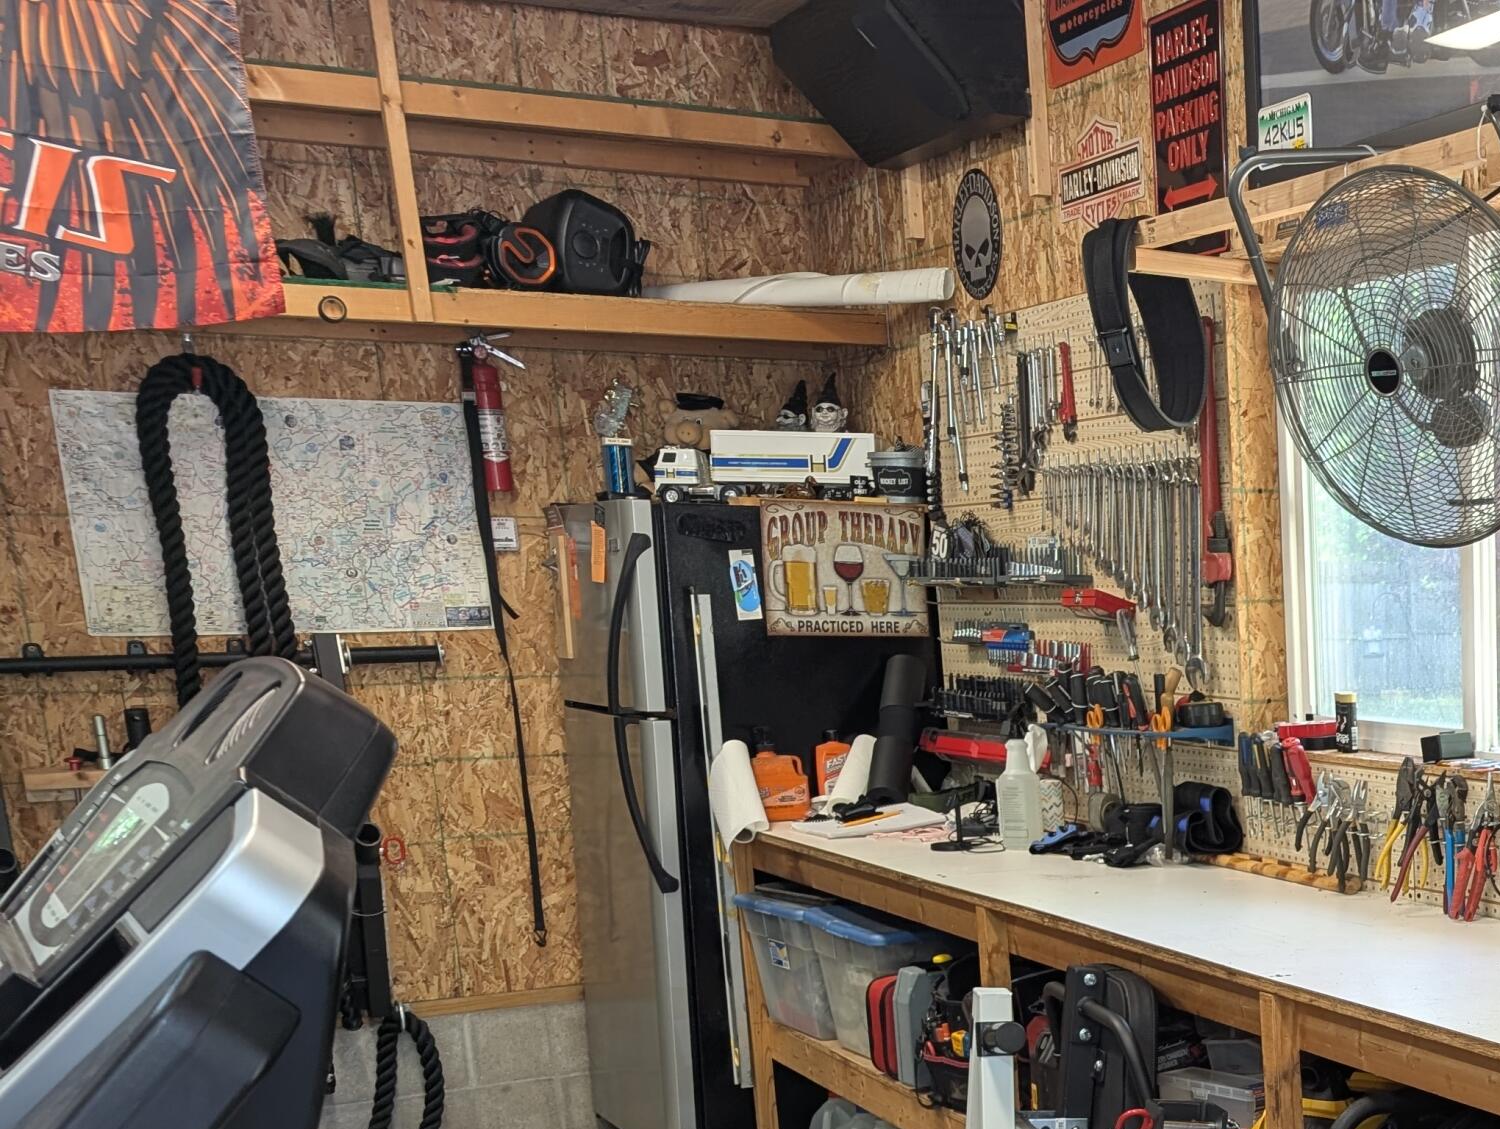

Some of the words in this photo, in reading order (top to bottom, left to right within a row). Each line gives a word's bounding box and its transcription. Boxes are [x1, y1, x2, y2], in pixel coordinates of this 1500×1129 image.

[1059, 0, 1123, 33] motorcycles
[1155, 14, 1213, 65] HARLEY-
[1154, 51, 1217, 104] DAVIDSON
[1156, 91, 1219, 141] PARKING
[1268, 103, 1300, 121] MICHIGAN
[1081, 129, 1114, 159] MOTOR
[1168, 130, 1210, 172] ONLY
[0, 131, 177, 254] IS
[1062, 152, 1138, 201] HARLEY-DAVIDSON
[1063, 207, 1081, 219] TRADE
[1122, 188, 1140, 200] MARK
[1085, 197, 1118, 223] CYCLES
[767, 511, 828, 561] GROUP
[838, 511, 922, 555] THERAPY
[931, 532, 948, 559] 50
[798, 620, 864, 633] PRACTICED
[871, 620, 900, 634] HERE
